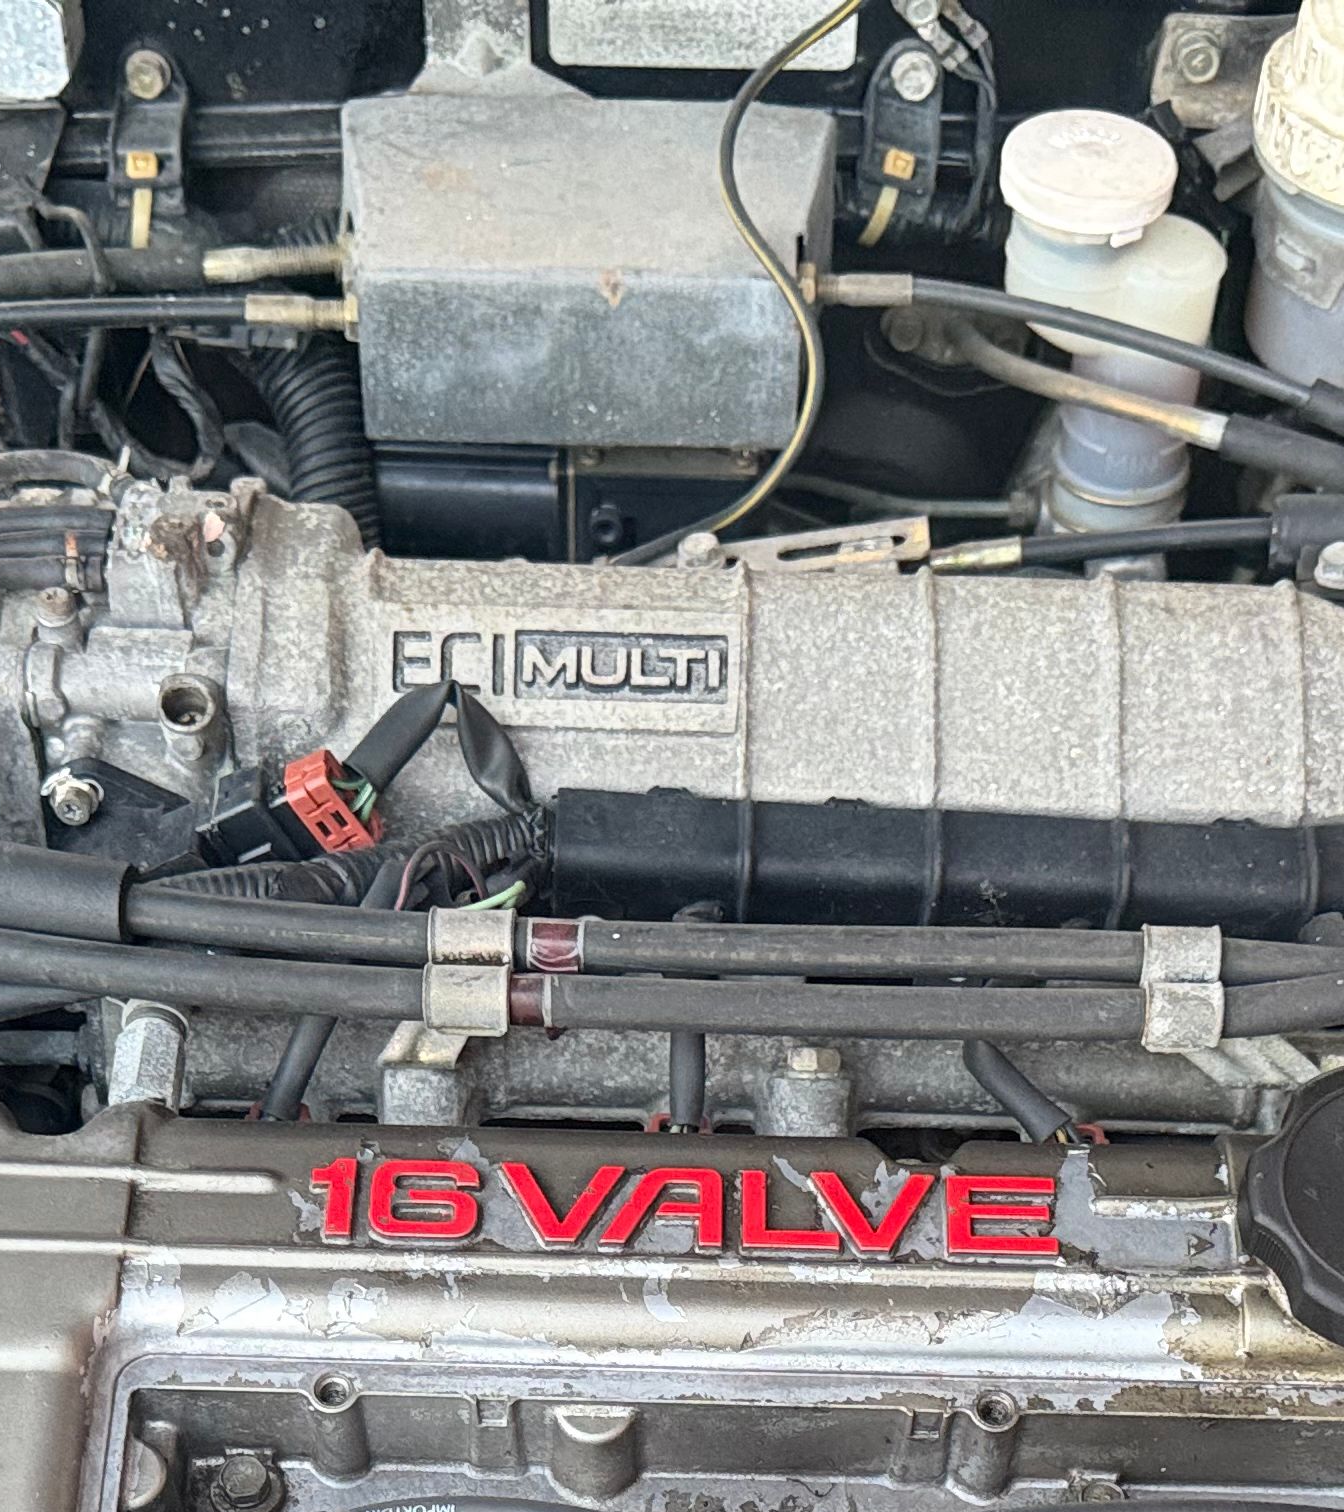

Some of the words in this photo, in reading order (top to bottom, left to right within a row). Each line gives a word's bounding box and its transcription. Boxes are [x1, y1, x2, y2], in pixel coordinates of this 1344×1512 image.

[521, 644, 722, 690] MULTI
[311, 1157, 481, 1245] 16
[498, 1160, 1060, 1262] VALVE
